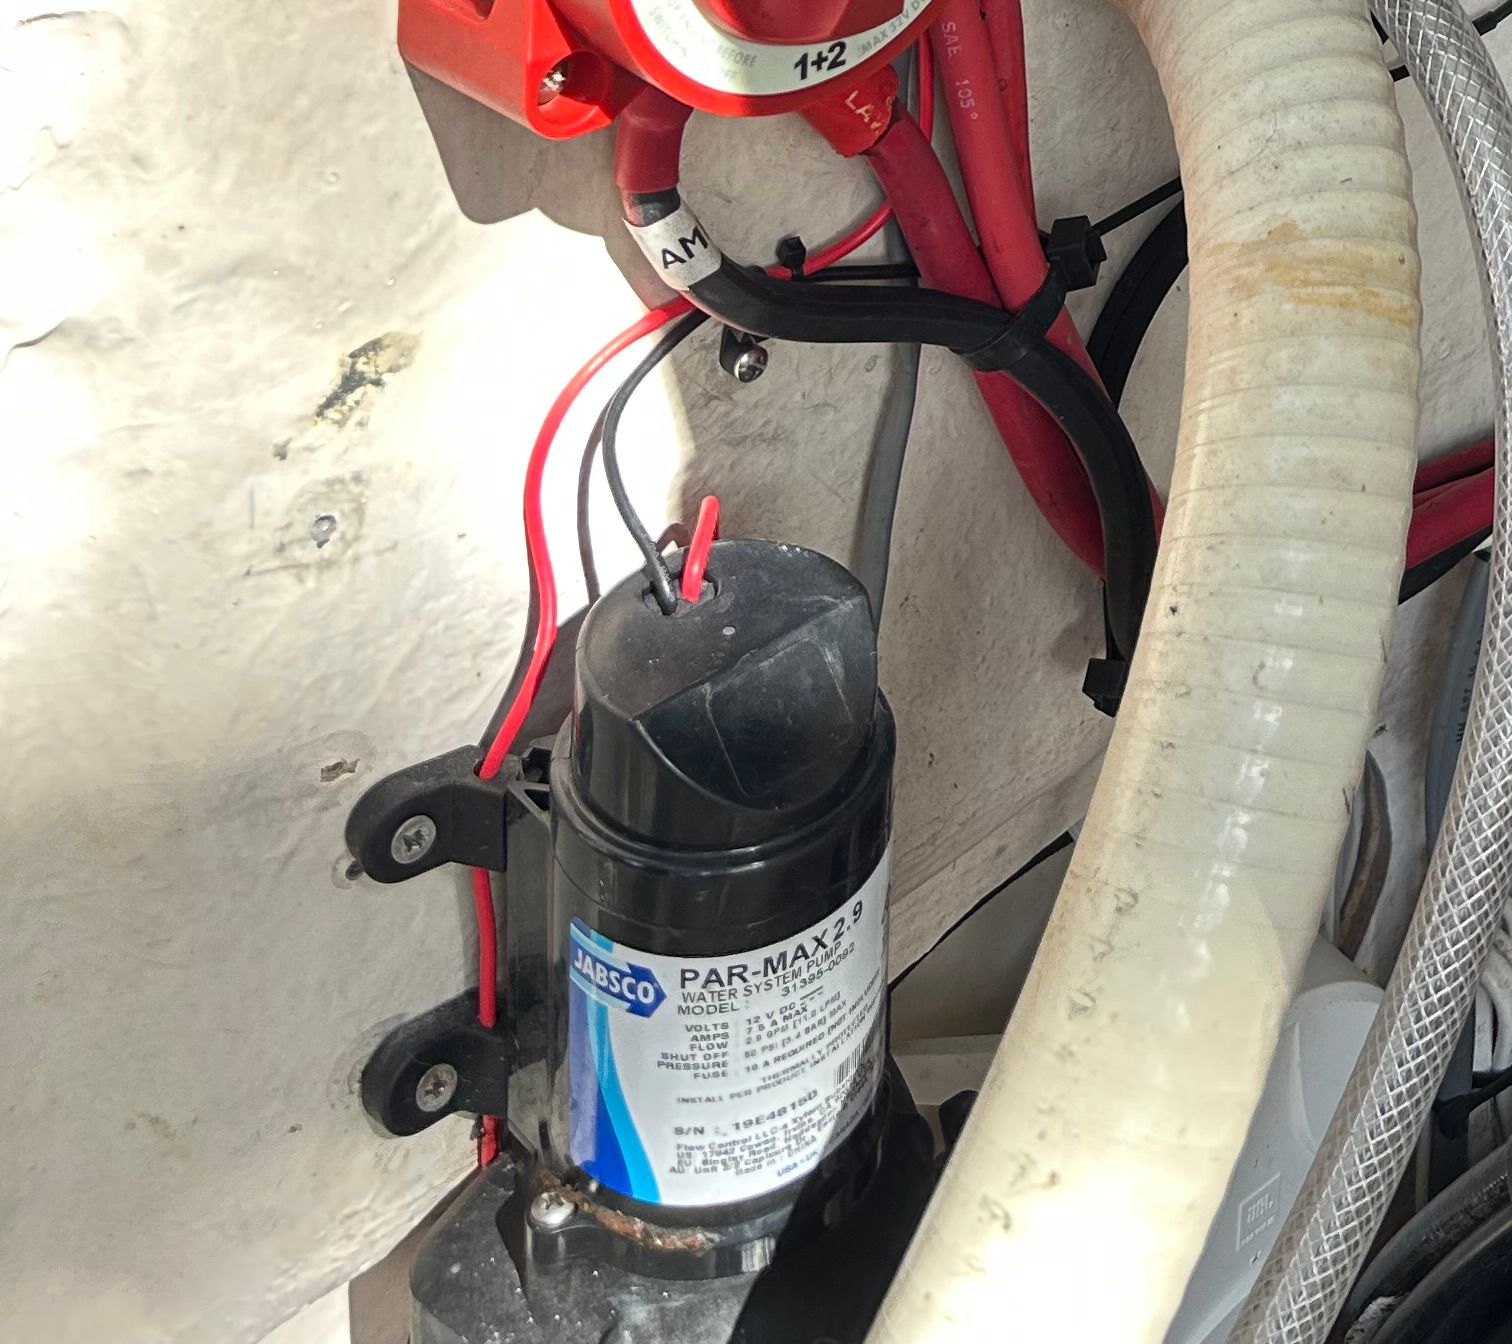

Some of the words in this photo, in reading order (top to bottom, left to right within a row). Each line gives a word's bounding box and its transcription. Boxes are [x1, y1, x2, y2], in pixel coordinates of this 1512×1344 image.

[860, 29, 889, 55] MAX
[942, 21, 961, 57] SAE
[792, 41, 847, 81] 1+2
[661, 224, 709, 270] AM
[679, 934, 829, 990] PAR-MAX
[833, 899, 864, 943] 2.9
[573, 947, 656, 1004] JABSCO
[677, 1002, 740, 1016] MODEL
[781, 942, 856, 998] 31395-0092
[681, 987, 738, 1004] WATER
[742, 966, 803, 998] SYSTEM
[806, 940, 842, 974] PUMP
[684, 1021, 730, 1033] VOLTS
[745, 1014, 761, 1026] 12
[766, 1011, 775, 1021] V
[779, 1002, 797, 1016] DC
[688, 1031, 730, 1042] AMPS
[770, 1019, 778, 1028] A
[783, 1004, 808, 1022] MAX
[660, 1051, 698, 1061] SHUT
[703, 1051, 729, 1061] OFF
[689, 1041, 730, 1051] FLOW
[693, 1070, 730, 1080] FUSE
[774, 1030, 826, 1066] REQUIRED
[656, 1059, 730, 1071] PRESSURE
[676, 1095, 724, 1104] INSTALL
[674, 1126, 705, 1136] S/N
